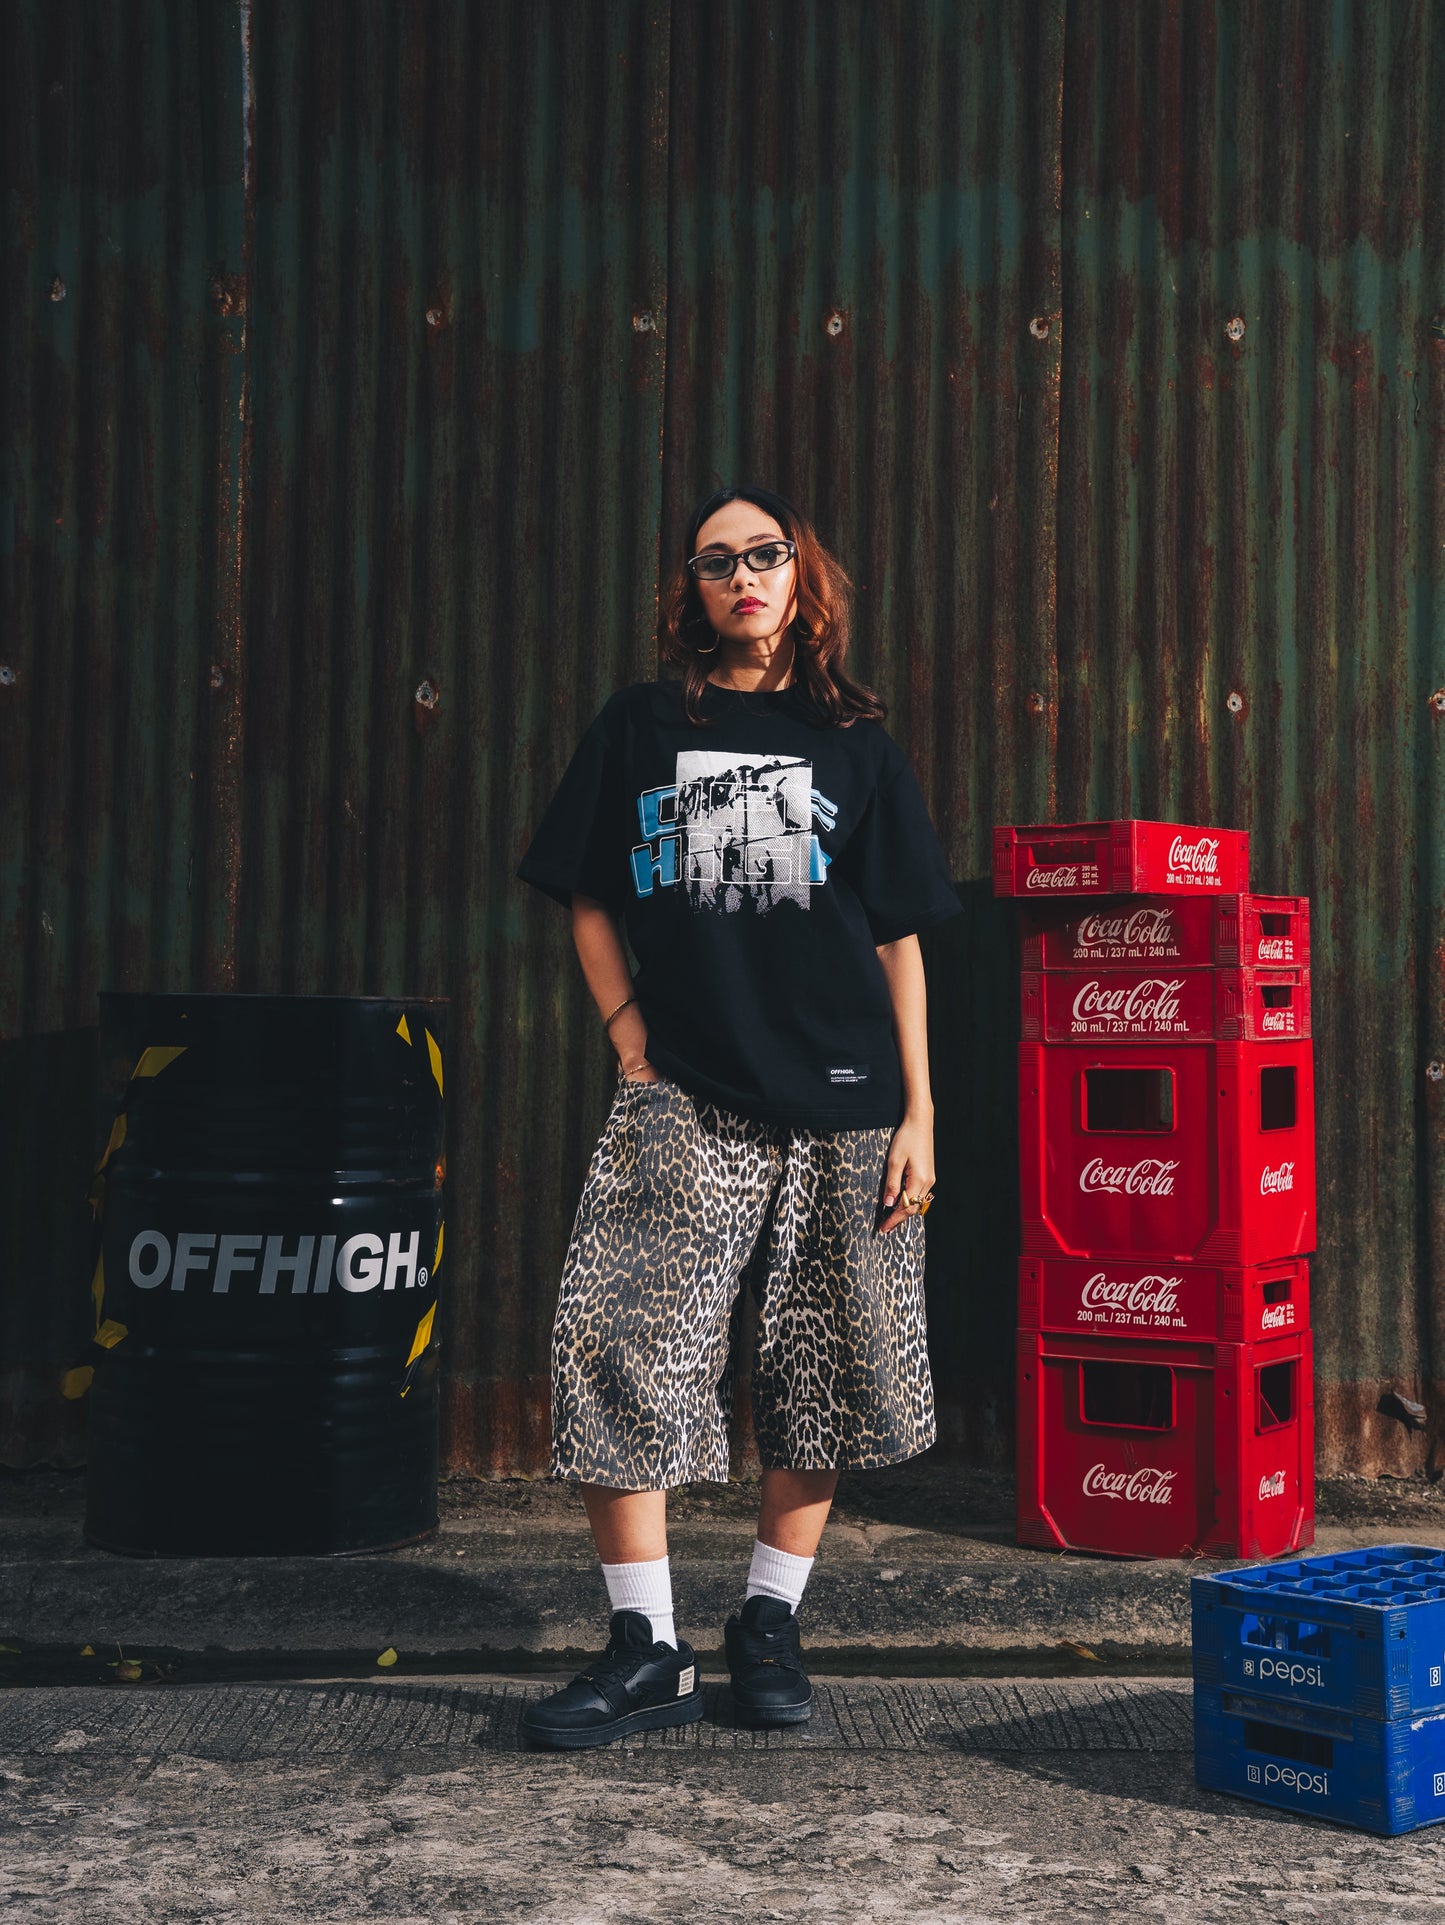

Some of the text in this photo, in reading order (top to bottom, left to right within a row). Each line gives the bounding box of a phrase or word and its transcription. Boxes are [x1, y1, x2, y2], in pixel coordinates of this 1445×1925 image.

[1168, 835, 1220, 873] Coca-Cola
[1026, 866, 1079, 889] Coca-Cola
[1077, 908, 1174, 946] Coca-Cola
[1073, 948, 1089, 958] 200
[1090, 947, 1104, 958] mL
[1110, 947, 1127, 958] 237
[1128, 946, 1142, 957] mL
[1149, 946, 1164, 957] 240
[1166, 946, 1180, 956] mL
[1258, 939, 1283, 960] Coca-Cola
[1072, 979, 1187, 1021] Coca-Cola
[1071, 1021, 1088, 1033] 200
[1090, 1021, 1105, 1033] mL
[1112, 1021, 1129, 1033] 237
[1131, 1021, 1147, 1033] mL
[1154, 1021, 1172, 1032] 240
[1174, 1020, 1190, 1032] mL
[1079, 1157, 1180, 1196] Coca-Cola
[1260, 1162, 1295, 1196] Coca-Cola
[1081, 1272, 1184, 1313] Coca-Cola
[1077, 1310, 1093, 1322] 200
[1094, 1312, 1109, 1323] mL
[1115, 1313, 1132, 1324] 237
[1133, 1314, 1148, 1326] mL
[1154, 1315, 1171, 1327] 240
[1172, 1316, 1188, 1328] mL
[1082, 1463, 1178, 1505] Coca-Cola
[1259, 1658, 1322, 1687] pepsi
[1431, 1668, 1440, 1685] 8
[1264, 1763, 1329, 1795] pepsi
